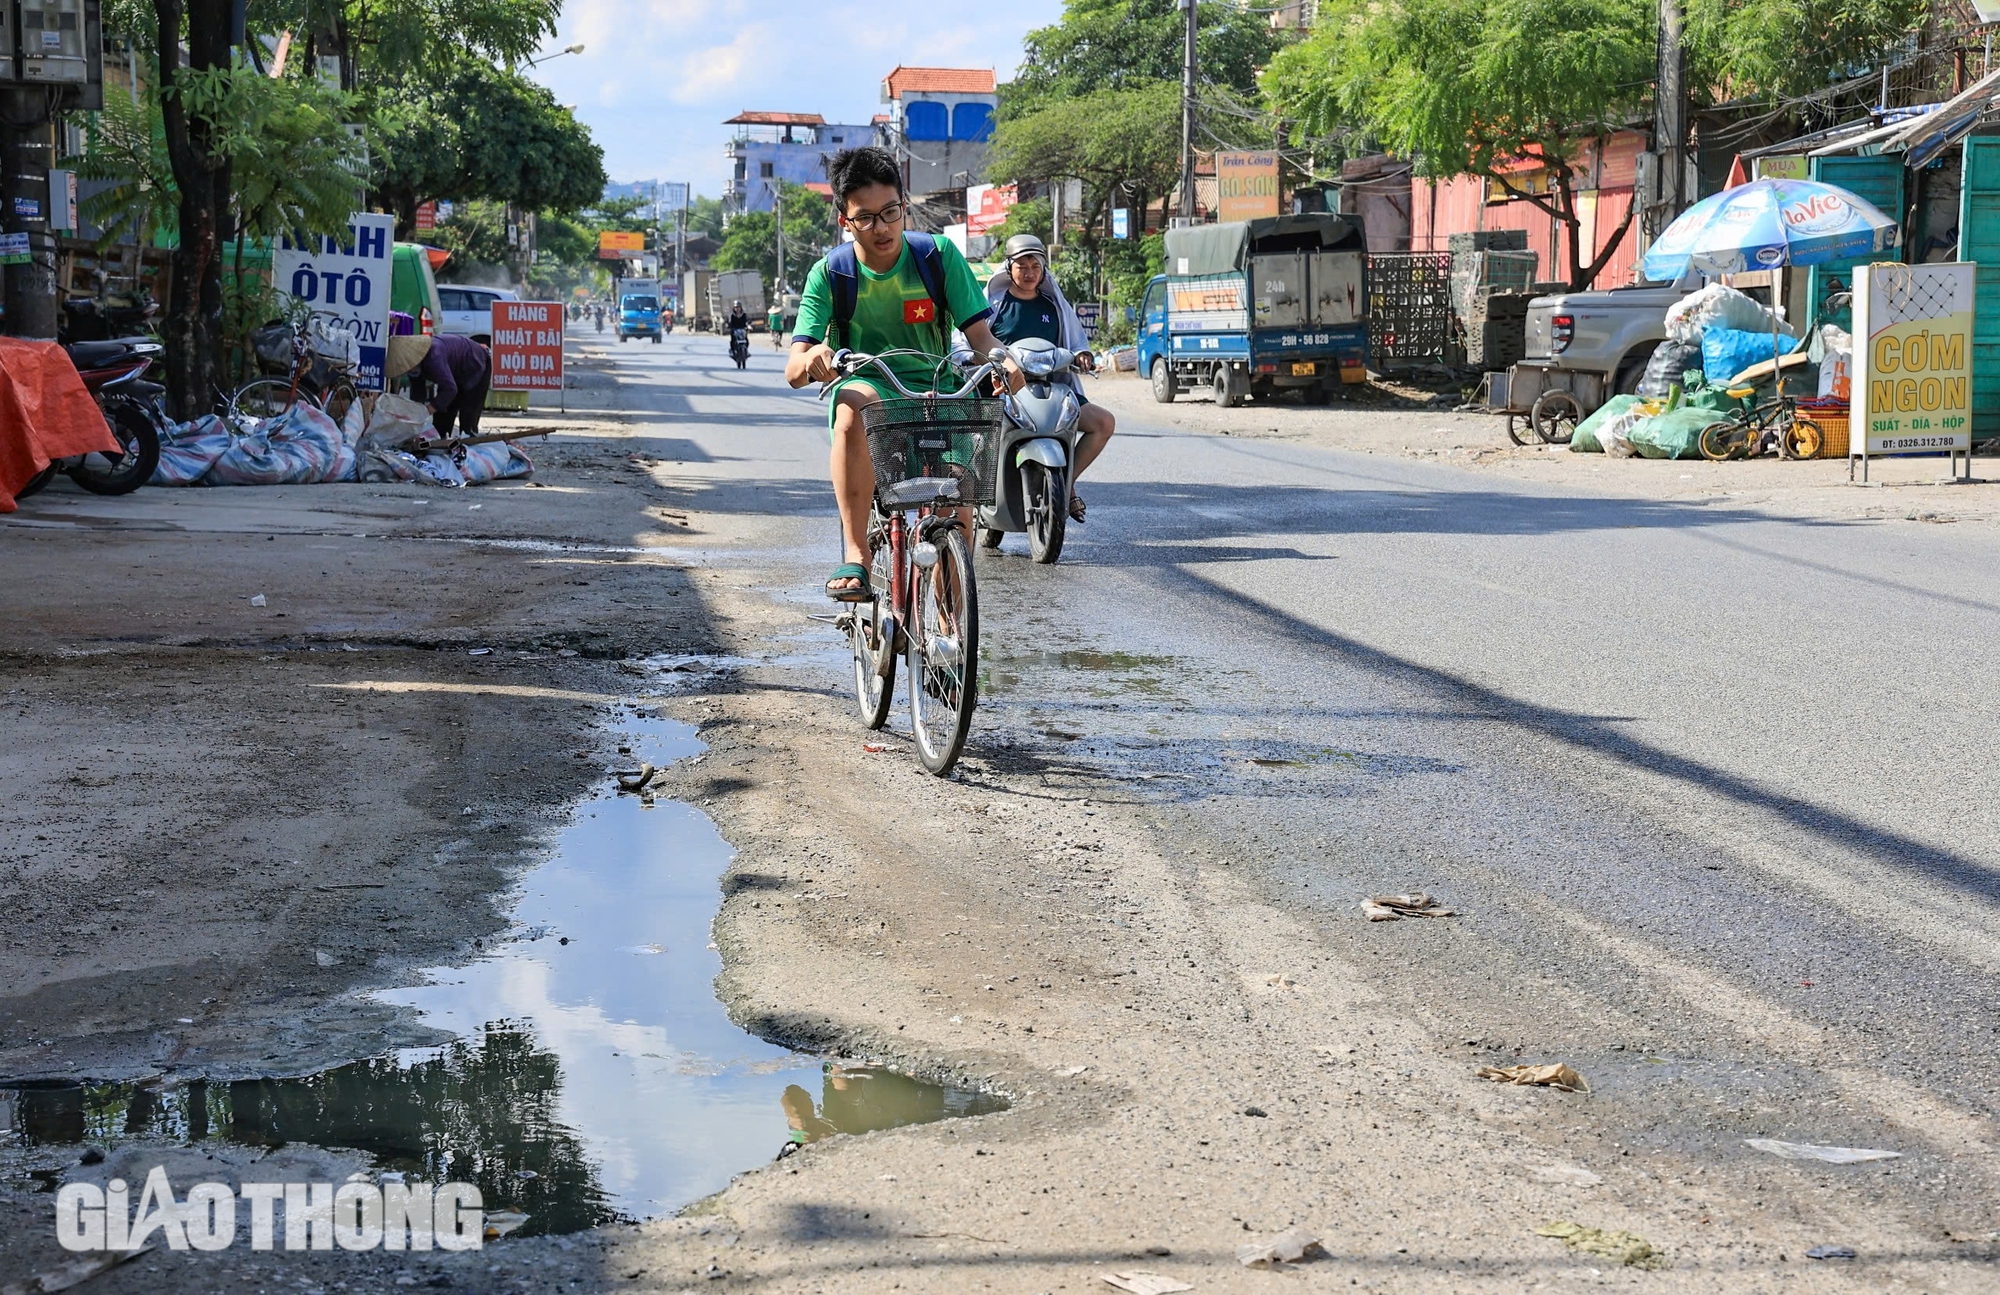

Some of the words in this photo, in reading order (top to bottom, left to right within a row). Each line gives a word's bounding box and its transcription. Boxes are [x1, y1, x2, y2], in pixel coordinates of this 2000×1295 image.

[292, 263, 371, 307] ÔTÔ
[1265, 281, 1285, 293] 24h
[508, 304, 548, 322] HÀNG
[495, 328, 533, 349] NHẬT
[537, 328, 561, 346] BÃI
[1281, 335, 1297, 347] 29H
[1875, 329, 1965, 374] CƠM
[501, 351, 526, 373] NỘI
[530, 354, 555, 374] ĐỊA
[1871, 377, 1967, 413] NGON
[1872, 416, 1900, 432] SUẤT
[1942, 415, 1965, 430] HỘP
[1898, 437, 1954, 448] 0326.312.780
